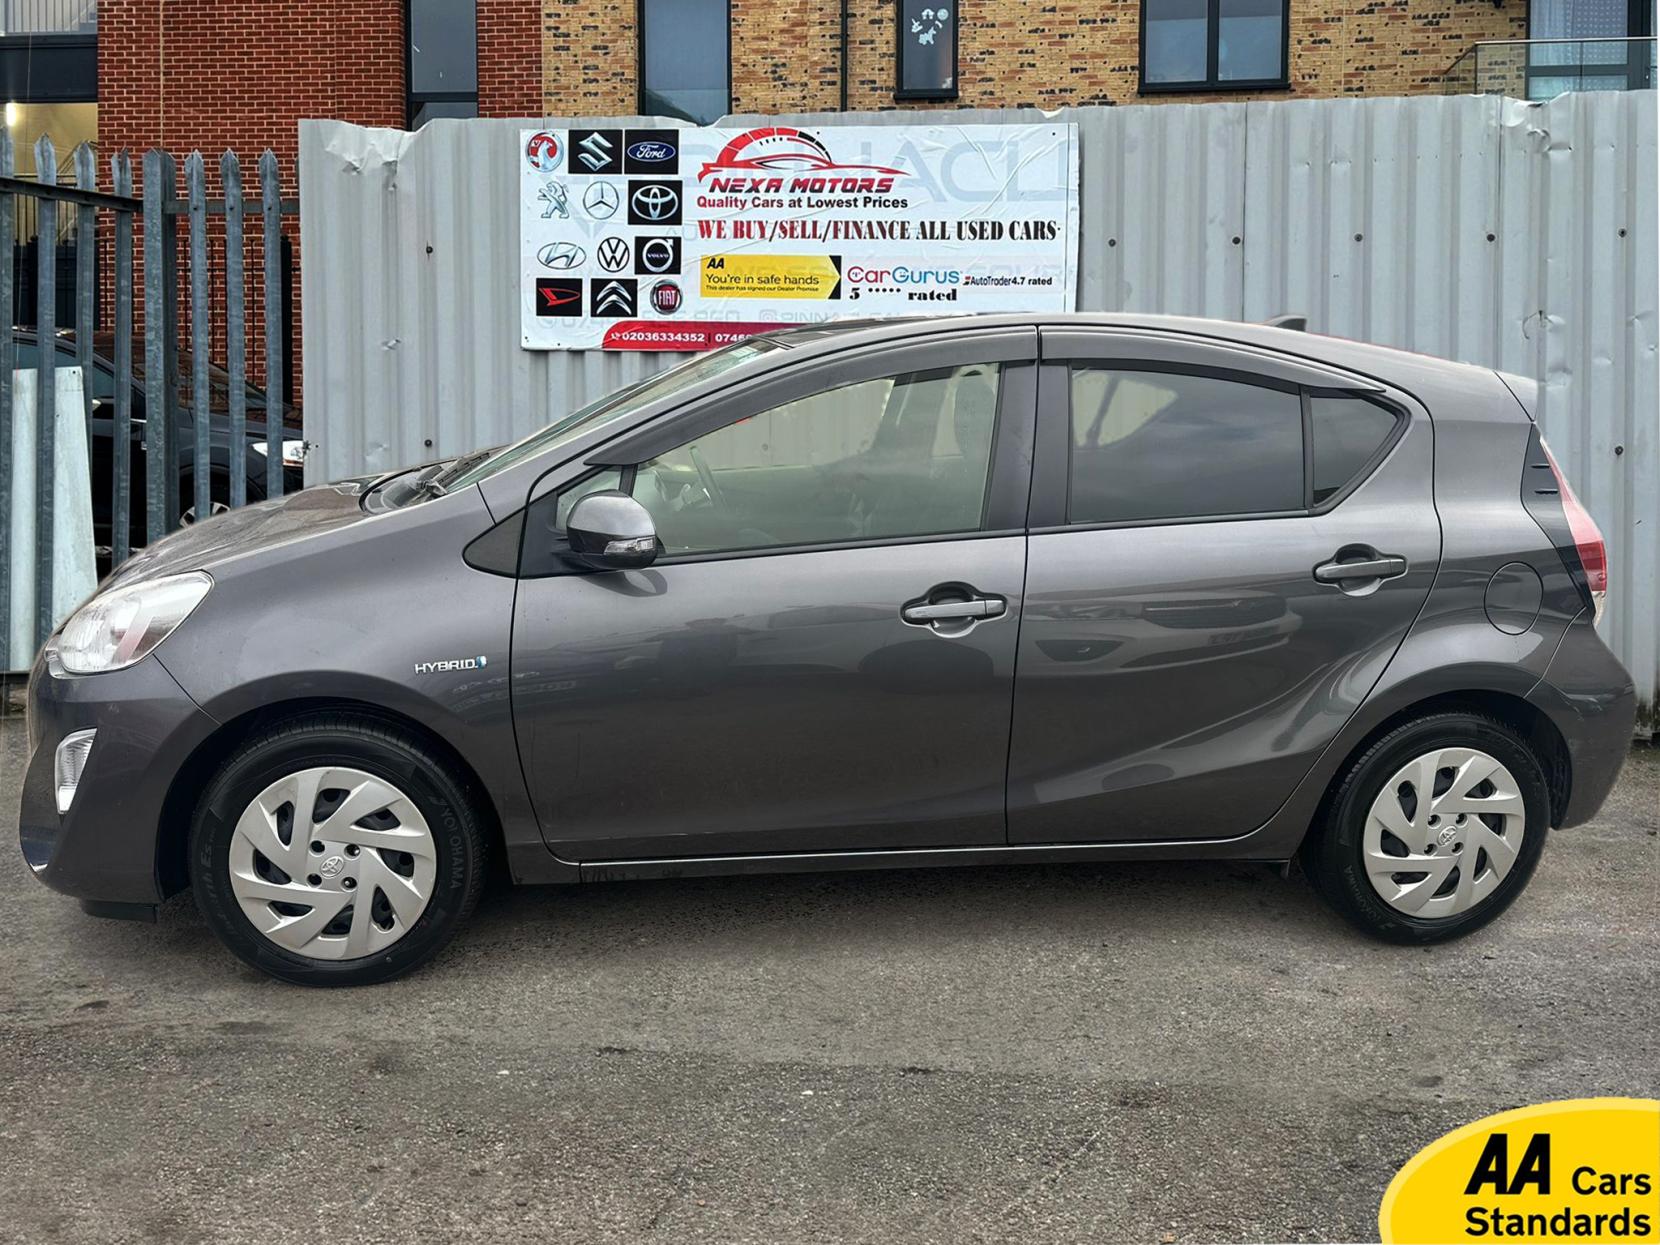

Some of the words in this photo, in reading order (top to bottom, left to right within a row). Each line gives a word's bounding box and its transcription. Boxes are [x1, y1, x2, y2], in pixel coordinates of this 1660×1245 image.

[637, 144, 666, 159] Ford
[709, 177, 784, 193] NEXA
[789, 177, 894, 193] MOTORS
[697, 195, 747, 210] Quality
[752, 195, 784, 208] Cars
[788, 196, 803, 208] at
[807, 196, 859, 208] Lowest
[863, 196, 908, 208] Prices
[697, 220, 726, 240] WE
[733, 220, 911, 243] BUY/SELL/FINANCE
[916, 221, 951, 241] ALL
[957, 221, 1004, 241] USED
[1009, 221, 1057, 241] CARS
[706, 256, 725, 269] AA
[705, 273, 741, 284] You're
[744, 273, 755, 284] in
[757, 273, 781, 285] safe
[784, 274, 819, 285] hands
[847, 266, 960, 284] CarGurus
[1028, 277, 1053, 286] rated
[658, 290, 676, 305] FIAT
[849, 287, 860, 301] 5
[908, 288, 958, 301] rated
[622, 333, 705, 342] 02036334352
[414, 658, 476, 674] HYBRID
